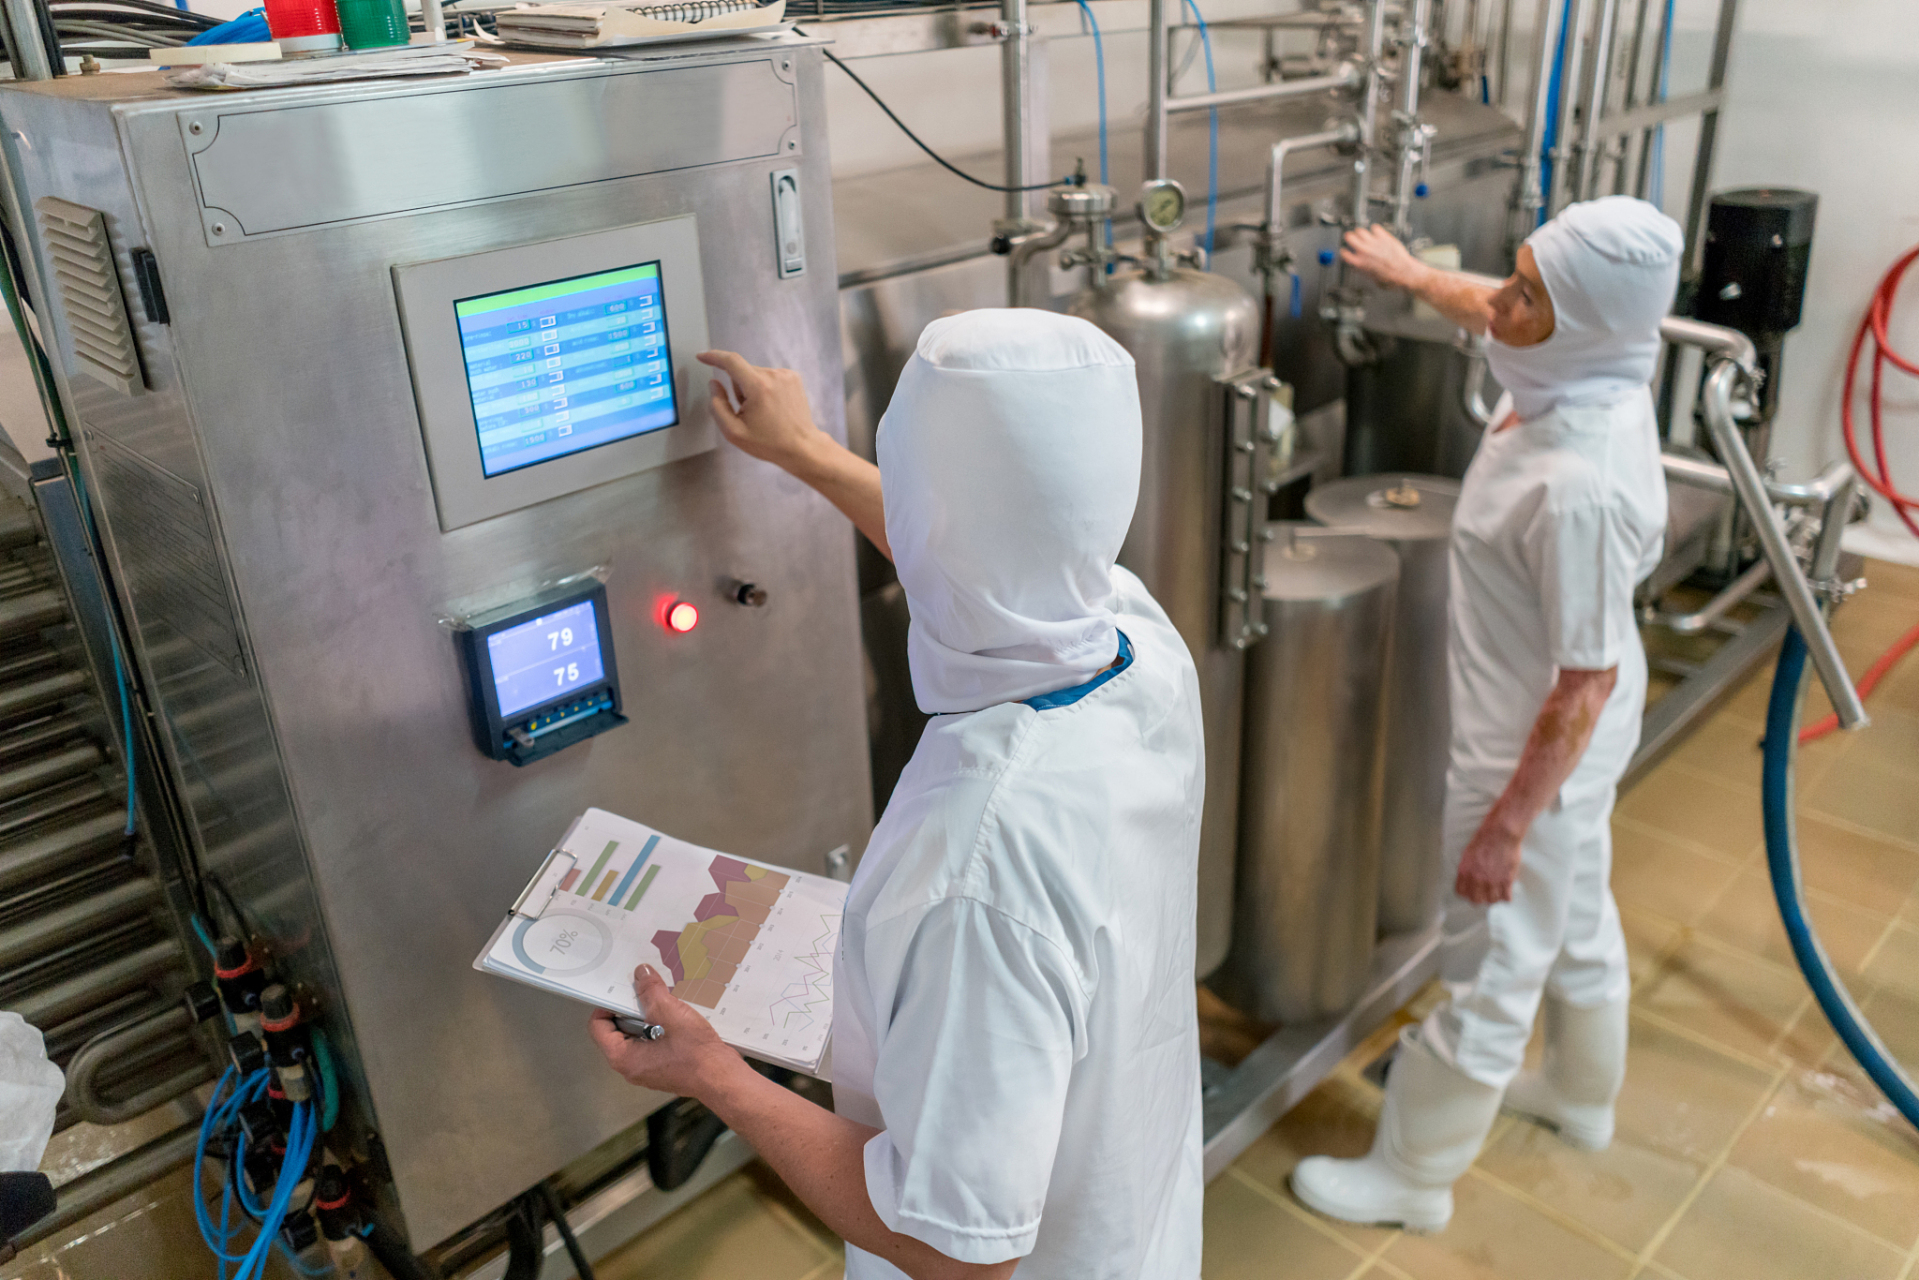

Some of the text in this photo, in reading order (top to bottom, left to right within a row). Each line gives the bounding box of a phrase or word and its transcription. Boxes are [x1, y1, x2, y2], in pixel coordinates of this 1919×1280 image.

[518, 321, 528, 329] 15
[515, 351, 531, 361] 220
[547, 627, 573, 651] 79
[553, 662, 579, 686] 75
[549, 928, 579, 955] 70%
[773, 949, 785, 961] 2014
